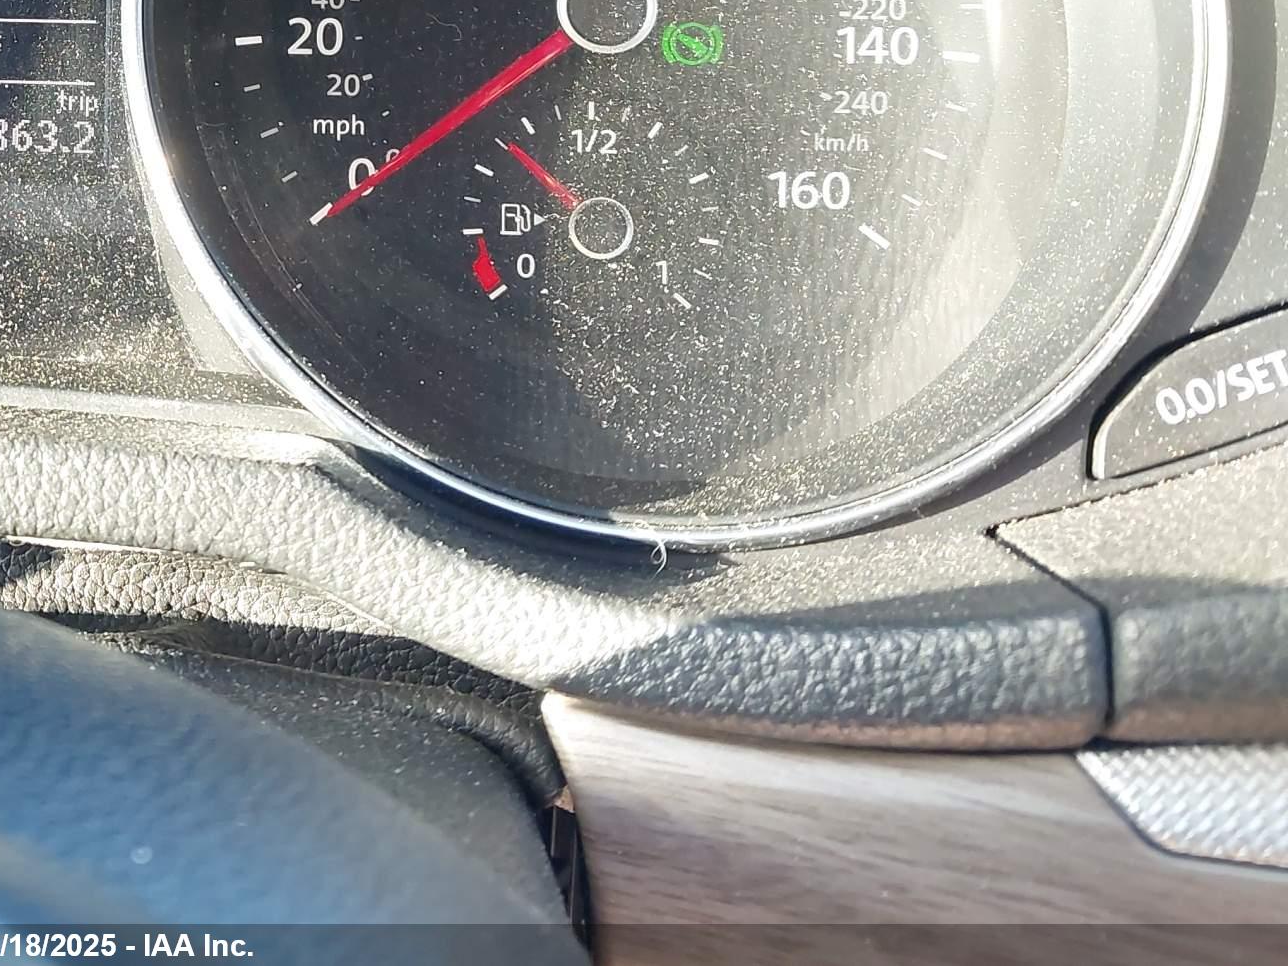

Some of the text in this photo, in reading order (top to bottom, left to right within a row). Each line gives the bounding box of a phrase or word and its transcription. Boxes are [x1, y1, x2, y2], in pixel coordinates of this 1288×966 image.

[287, 18, 343, 55] 20
[839, 27, 918, 64] 140
[327, 74, 360, 96] 20
[56, 89, 98, 115] trip
[833, 91, 889, 115] 240
[313, 114, 365, 140] mph
[571, 129, 618, 154] 1/2
[814, 132, 869, 153] km/h
[349, 157, 376, 196] 0
[769, 172, 850, 209] 160
[516, 253, 535, 278] 0
[1155, 349, 1288, 425] 0.0/SET
